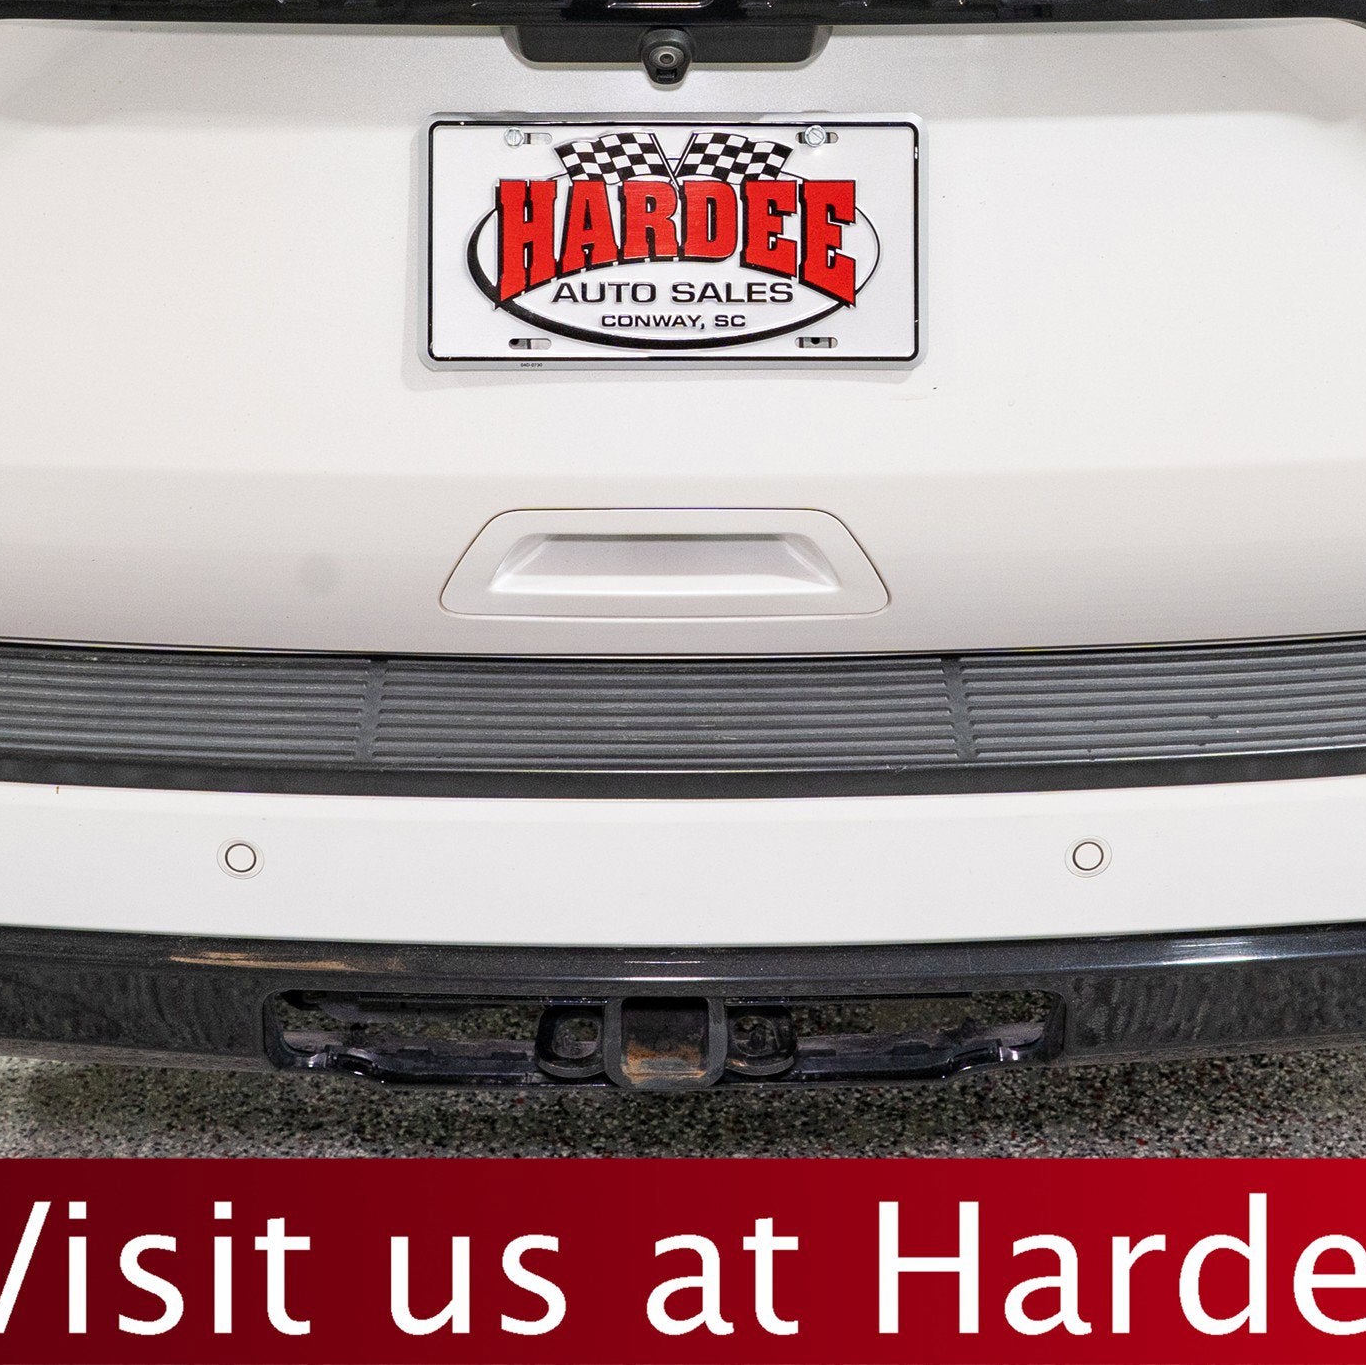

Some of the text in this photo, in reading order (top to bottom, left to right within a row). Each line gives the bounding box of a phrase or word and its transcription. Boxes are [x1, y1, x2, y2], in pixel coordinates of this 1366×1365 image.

[494, 179, 857, 308] HARDEE
[552, 282, 794, 304] AUTO SALES
[601, 314, 746, 330] CONWAY, SC
